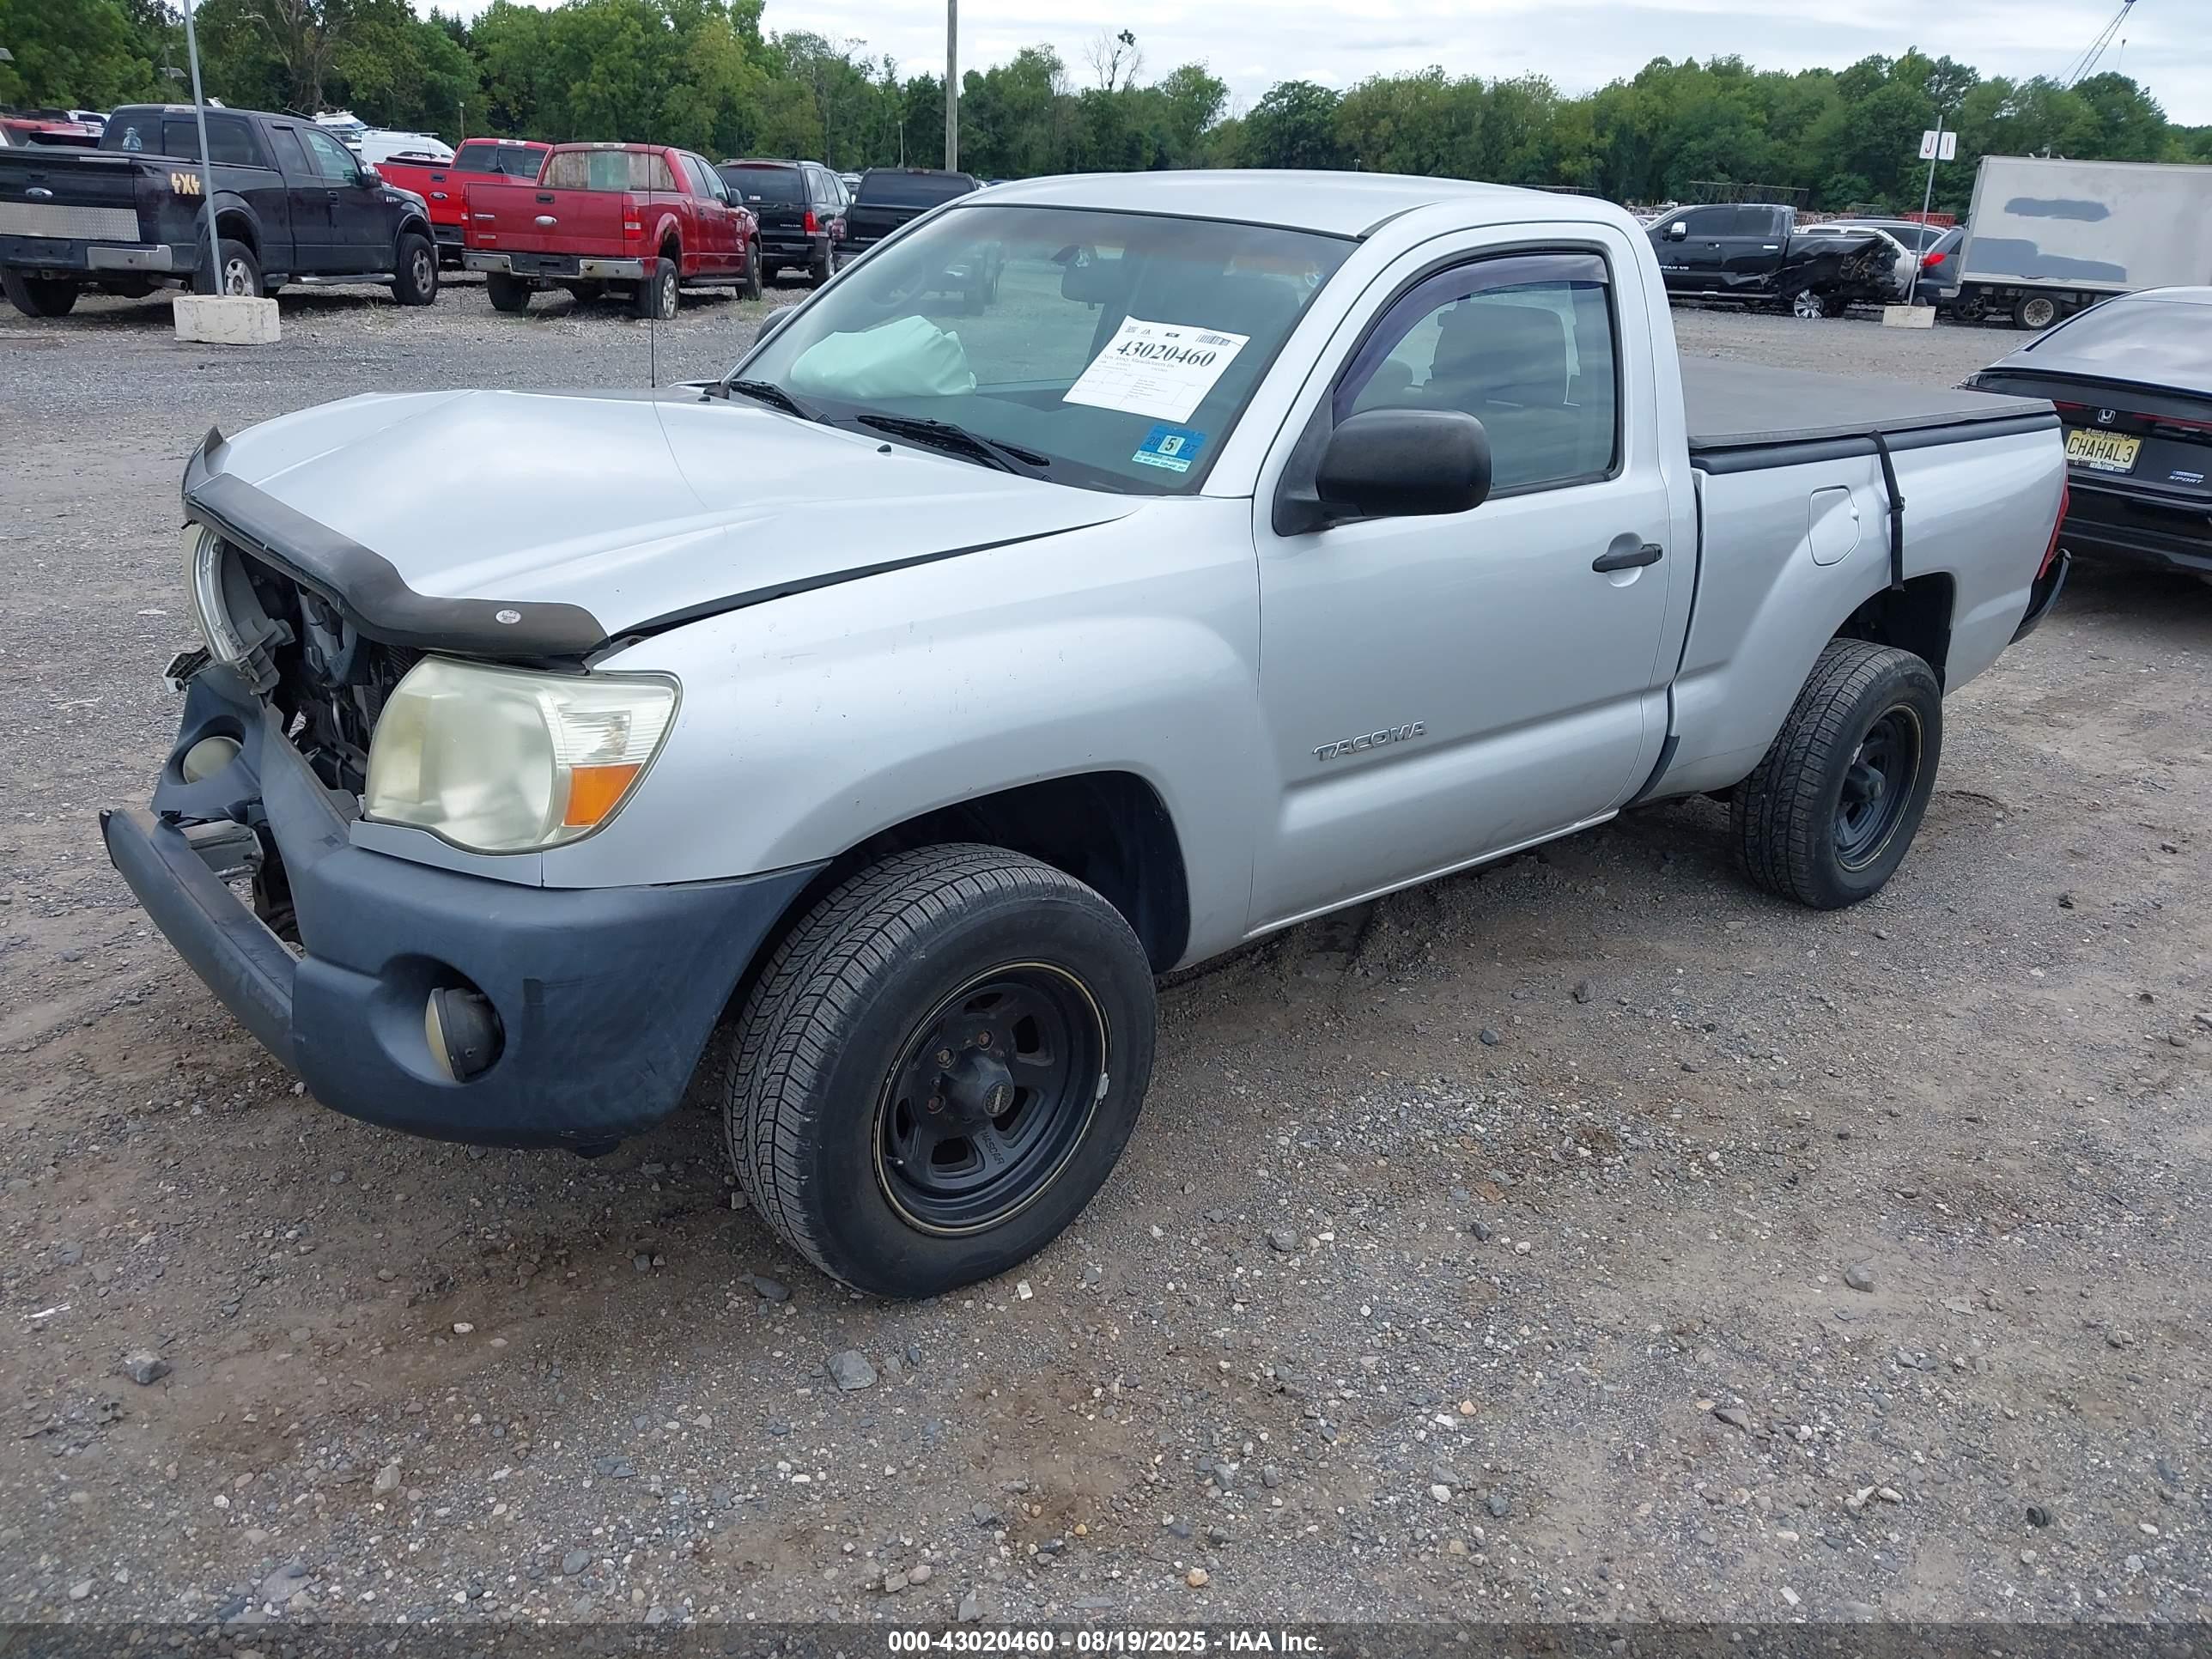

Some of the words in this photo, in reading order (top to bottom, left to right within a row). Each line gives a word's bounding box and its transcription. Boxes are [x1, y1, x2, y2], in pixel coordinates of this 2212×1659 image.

[1924, 136, 1935, 154] J
[1116, 340, 1217, 367] 43020460
[1164, 437, 1177, 452] 5
[2067, 436, 2135, 464] CHAHAL3
[2167, 475, 2204, 484] SPORT
[1312, 720, 1428, 761] TACOMA
